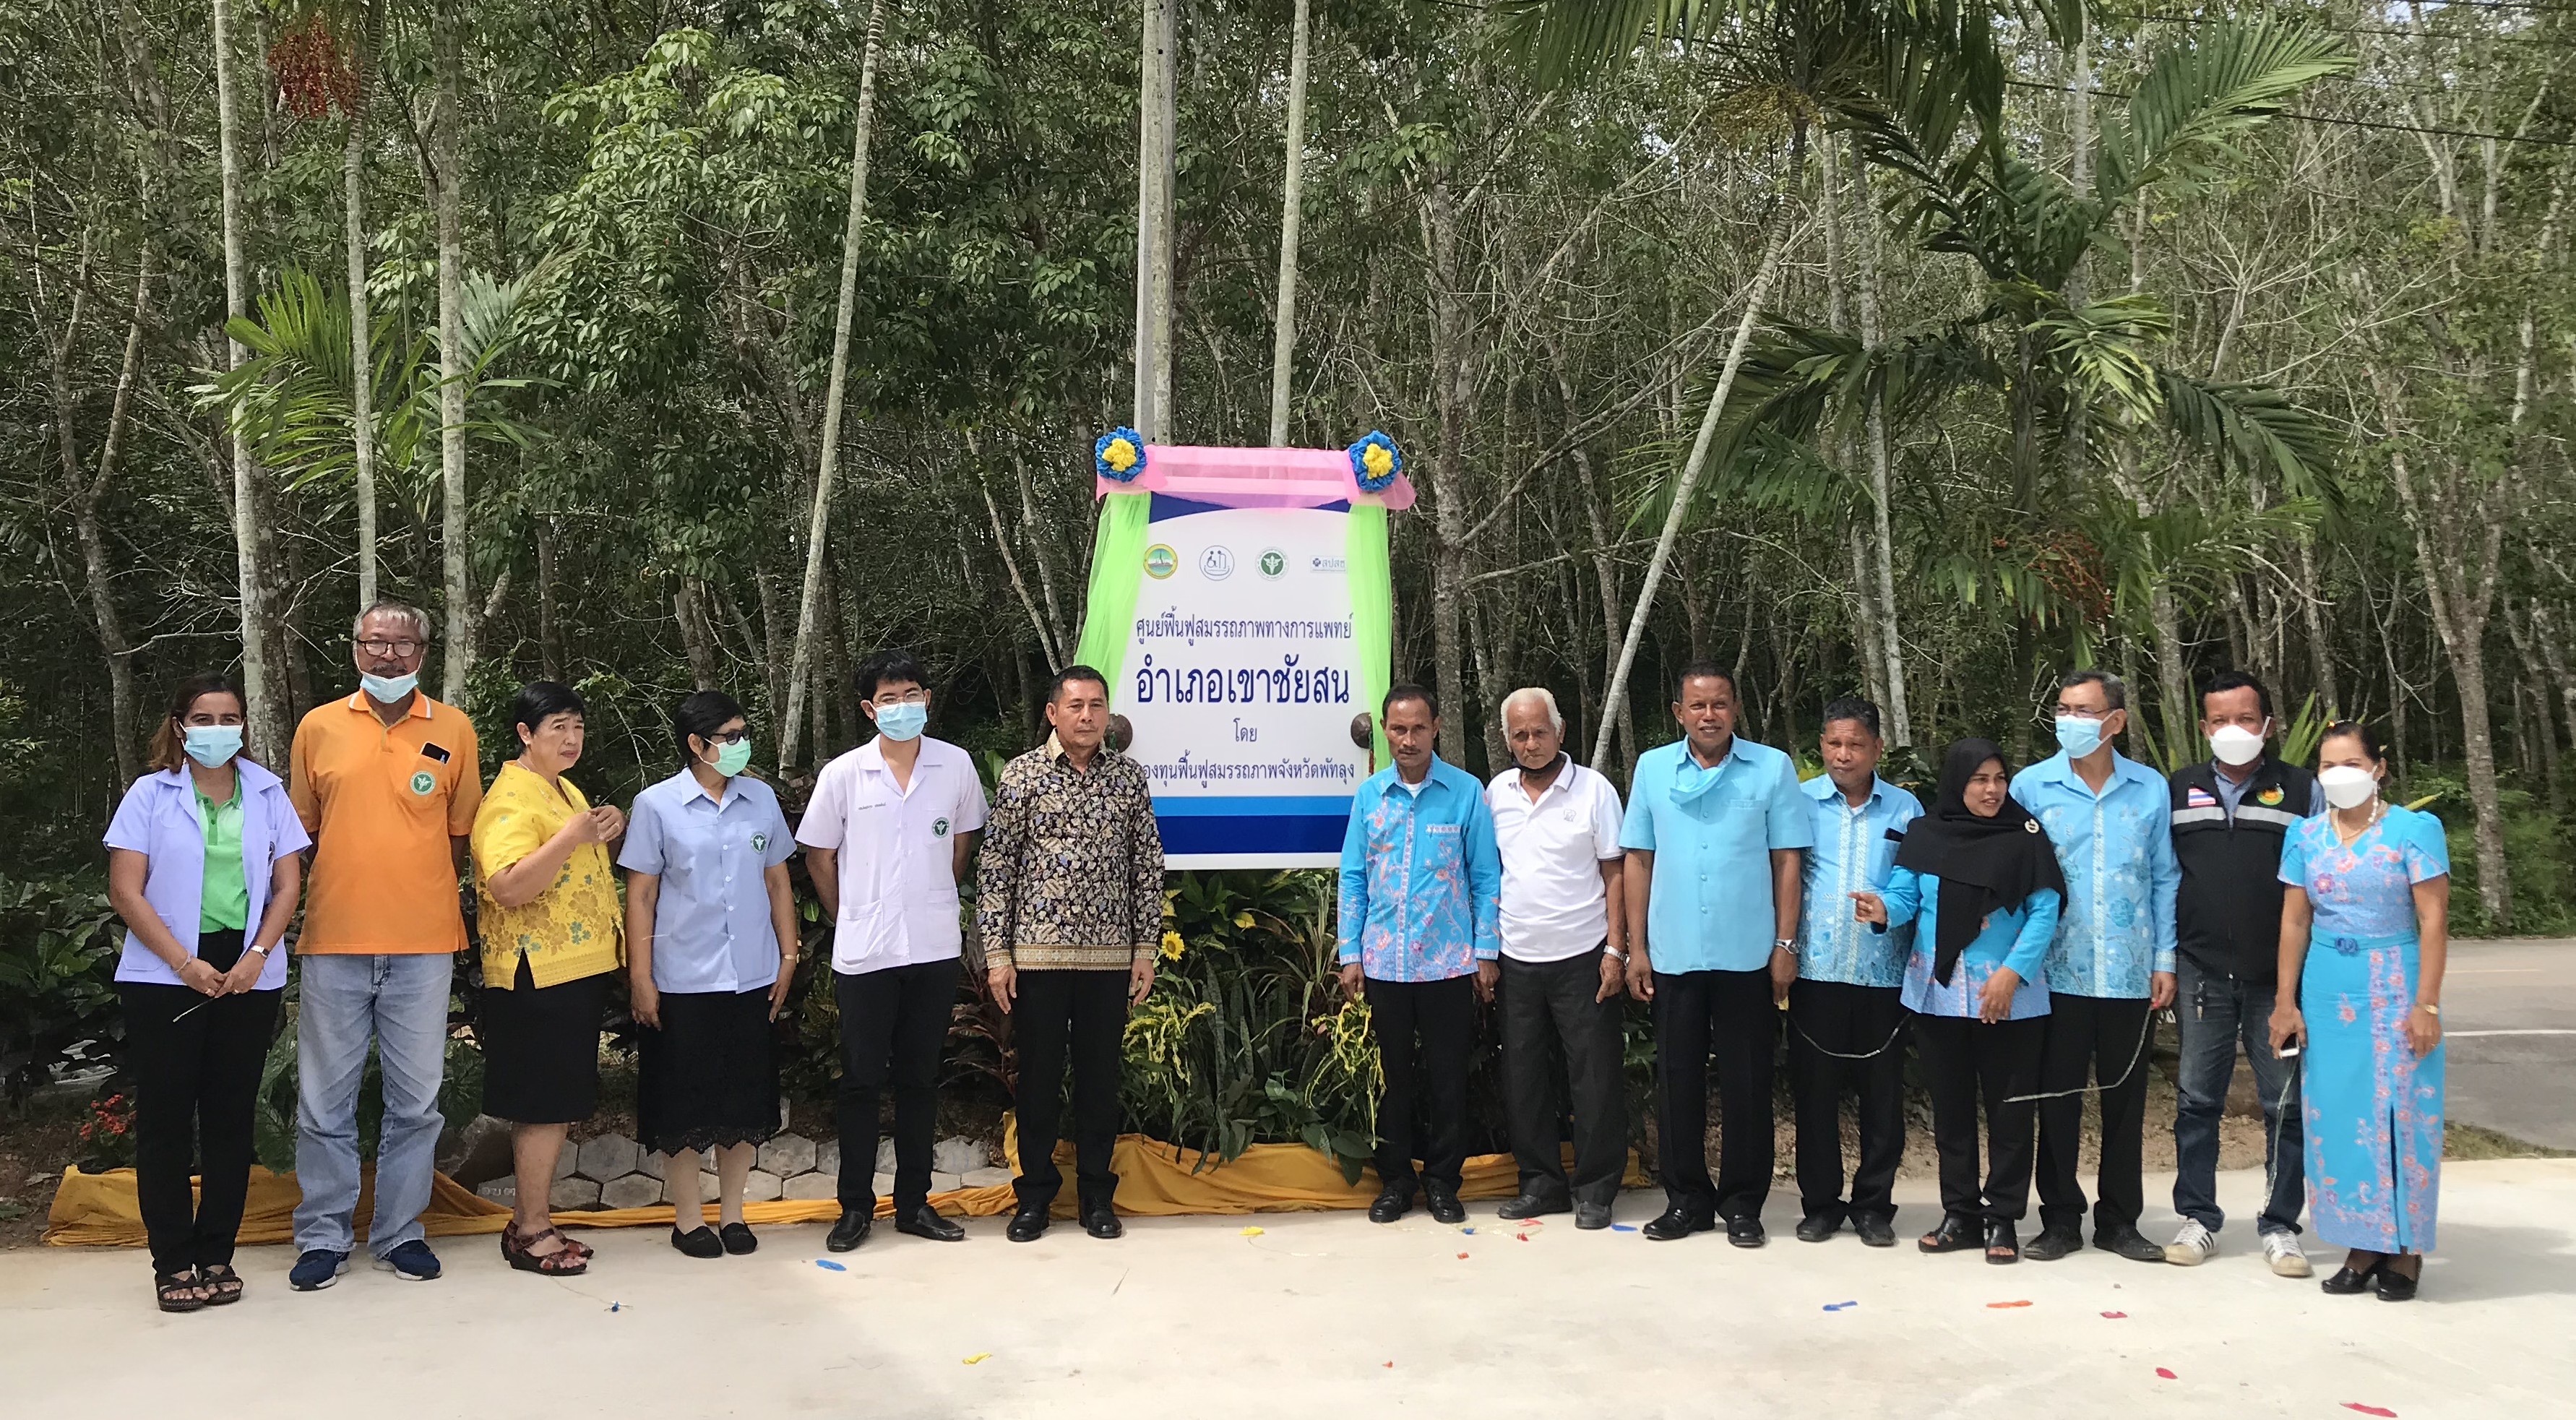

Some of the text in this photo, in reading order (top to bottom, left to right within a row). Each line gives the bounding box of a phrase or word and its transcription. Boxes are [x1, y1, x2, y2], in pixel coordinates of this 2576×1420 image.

[1137, 606, 1353, 646] ศูนย์ฟื้นฟูสมรรถภาพทางการแพทย์
[1137, 653, 1349, 703] อำเภอเขาชัยสน
[1233, 718, 1257, 742] โดย
[1142, 749, 1354, 788] องทุนฟื้นฟูสมรรถภาพจังหวัดพัทลุง
